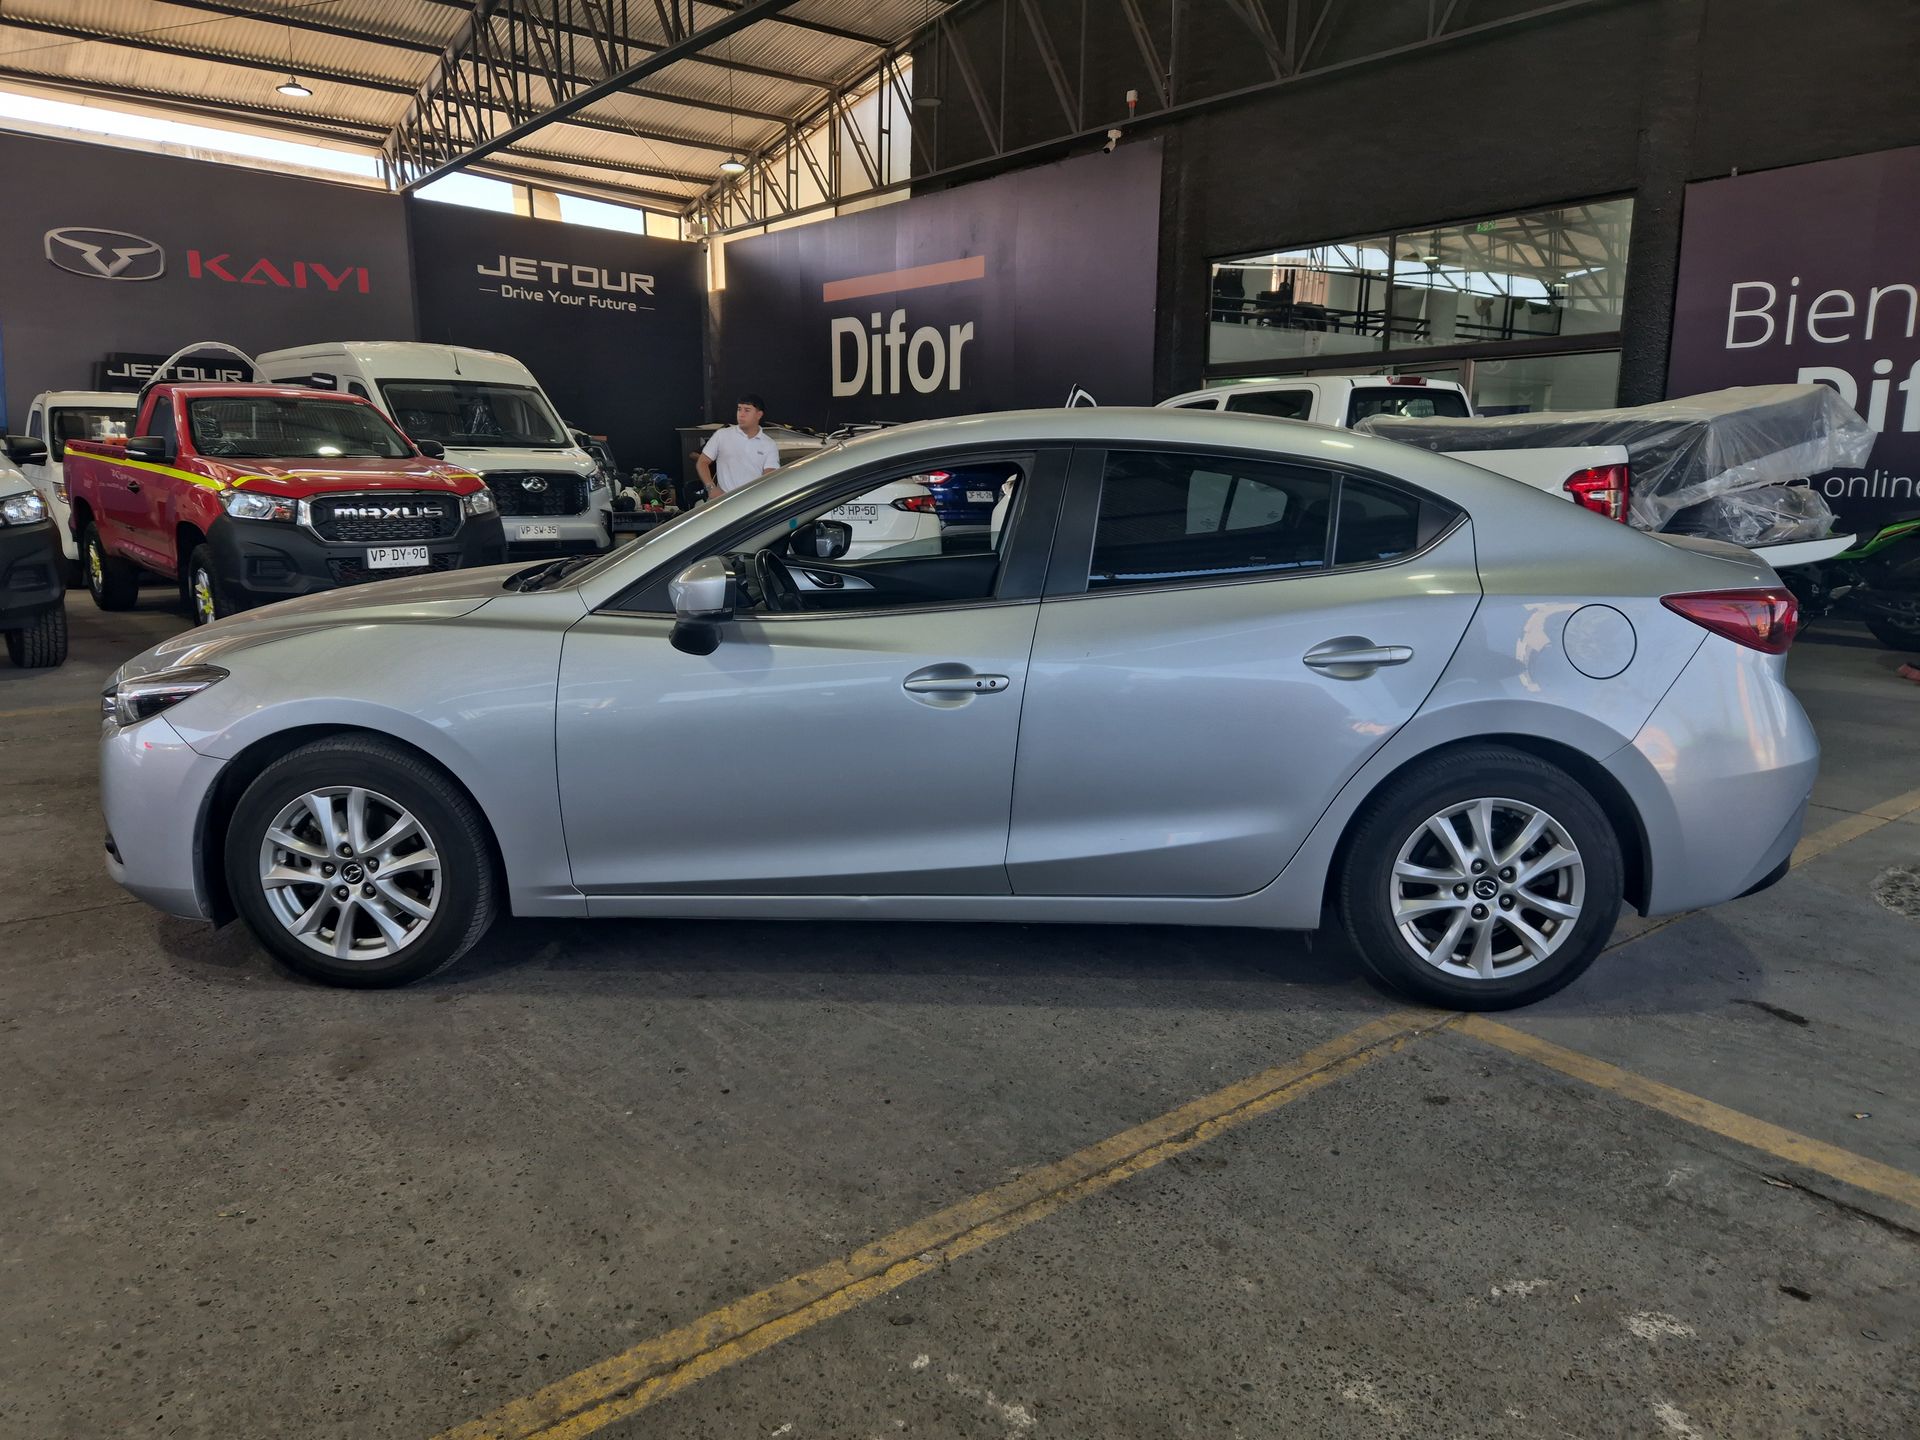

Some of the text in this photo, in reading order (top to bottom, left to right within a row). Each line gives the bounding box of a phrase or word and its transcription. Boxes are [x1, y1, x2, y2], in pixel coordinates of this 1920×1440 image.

[187, 250, 369, 293] KAIYI
[477, 255, 655, 295] JETOUR
[502, 285, 637, 312] Drive Your Future
[1725, 276, 1919, 349] Bien
[831, 308, 974, 397] Difor
